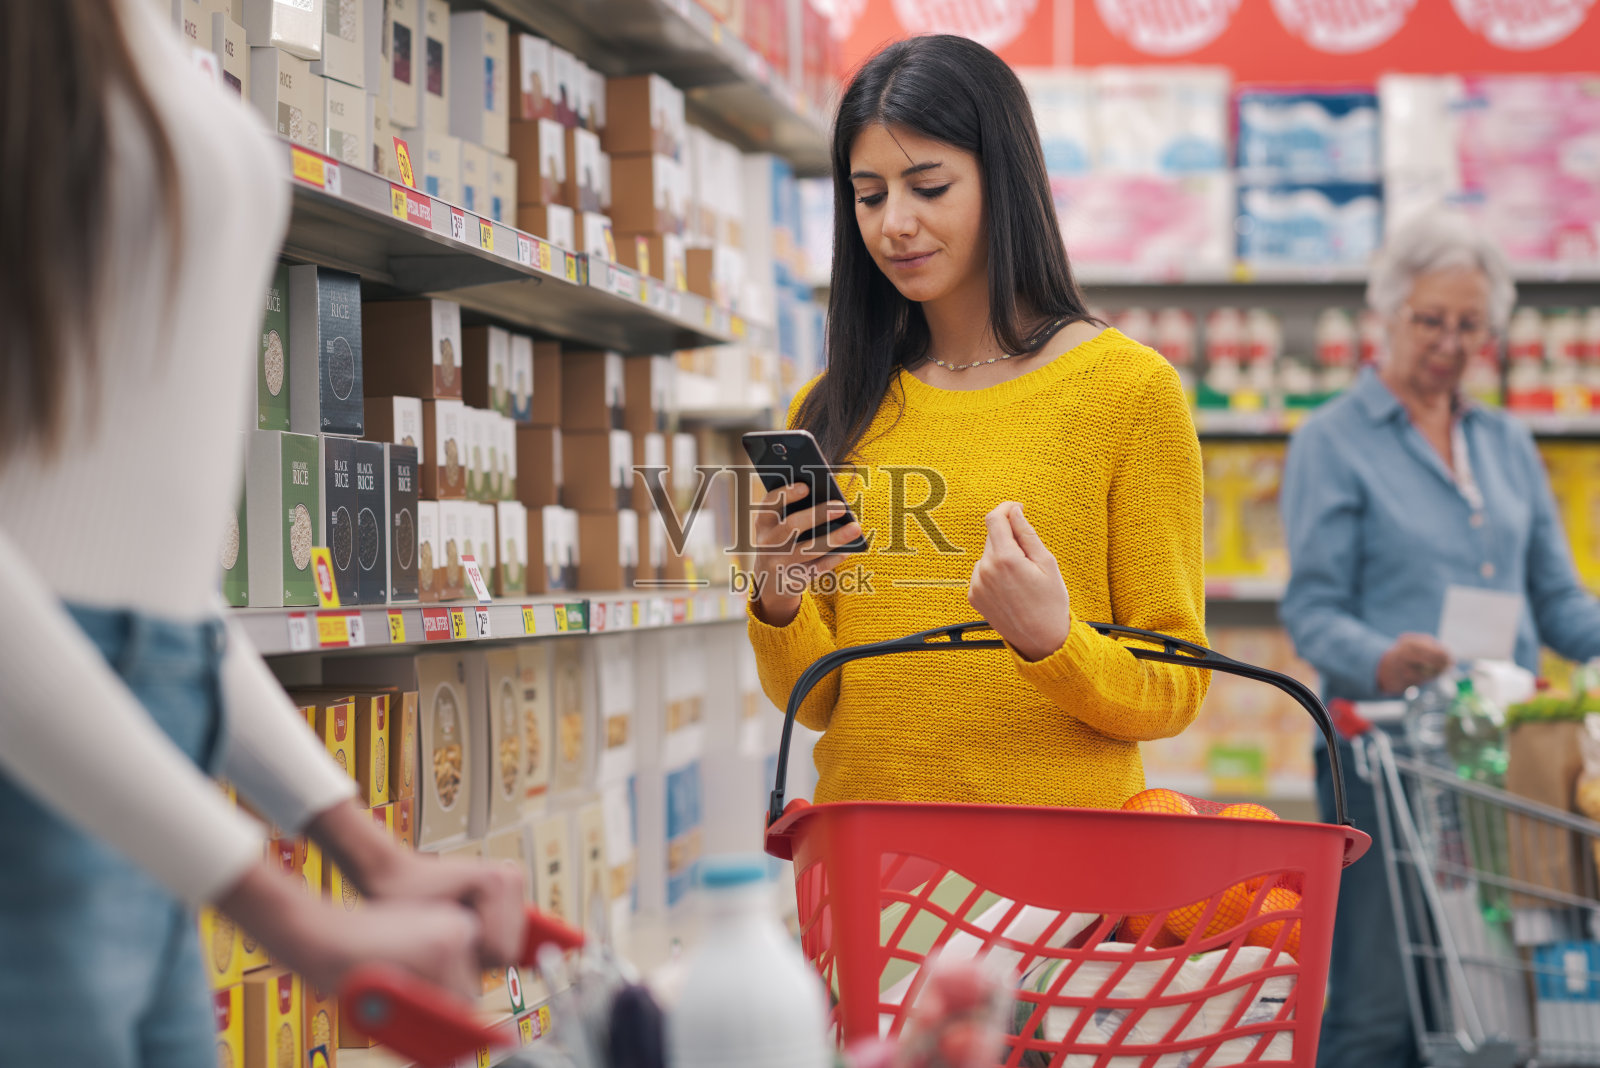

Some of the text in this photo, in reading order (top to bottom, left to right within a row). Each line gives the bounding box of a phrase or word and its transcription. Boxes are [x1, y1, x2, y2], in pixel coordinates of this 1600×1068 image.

[225, 38, 234, 58] RICE
[279, 71, 292, 89] RICE
[329, 99, 345, 117] RICE
[419, 203, 431, 221] OFFERS
[331, 303, 350, 319] RICE
[334, 459, 349, 471] BLACK
[356, 462, 373, 474] BLACK
[398, 464, 411, 476] BLACK
[292, 470, 309, 486] RICE
[334, 472, 350, 488] RICE
[357, 475, 374, 491] RICE
[398, 477, 412, 492] RICE
[423, 616, 449, 631] SPECIAL OFFERS
